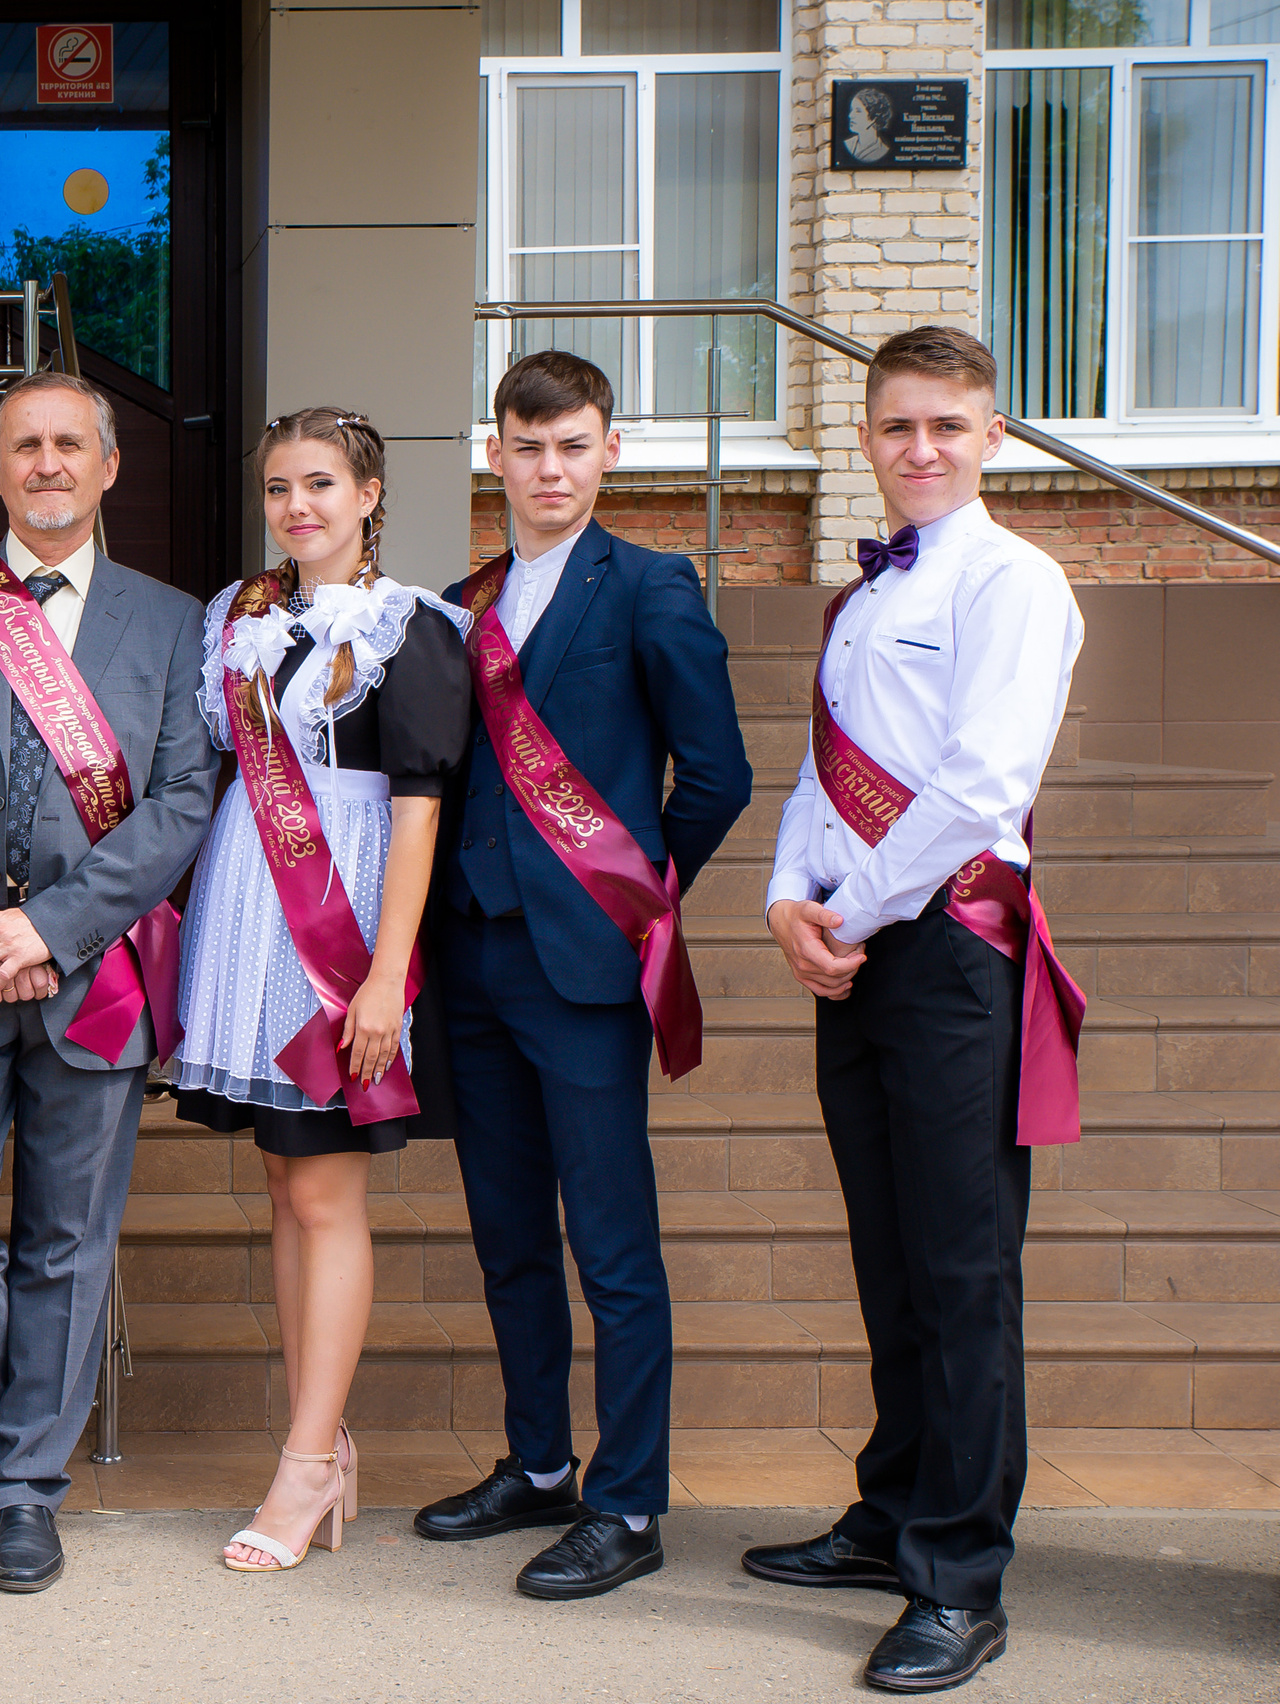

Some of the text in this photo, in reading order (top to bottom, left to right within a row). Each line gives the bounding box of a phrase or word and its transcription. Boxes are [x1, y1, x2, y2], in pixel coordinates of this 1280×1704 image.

[15, 677, 32, 697] СОШ
[26, 695, 41, 711] №17
[36, 710, 45, 722] им.
[51, 736, 78, 778] Навальневой
[51, 654, 118, 767] Анисимов Эдуард Витальевич
[230, 712, 242, 730] СОШ
[236, 730, 246, 747] №17
[525, 720, 550, 755] Николай
[42, 695, 120, 827] руководитель
[275, 738, 291, 768] Ксения
[843, 748, 905, 802] Топоров Сергей
[275, 803, 315, 858] 2023
[545, 781, 604, 838] 2023
